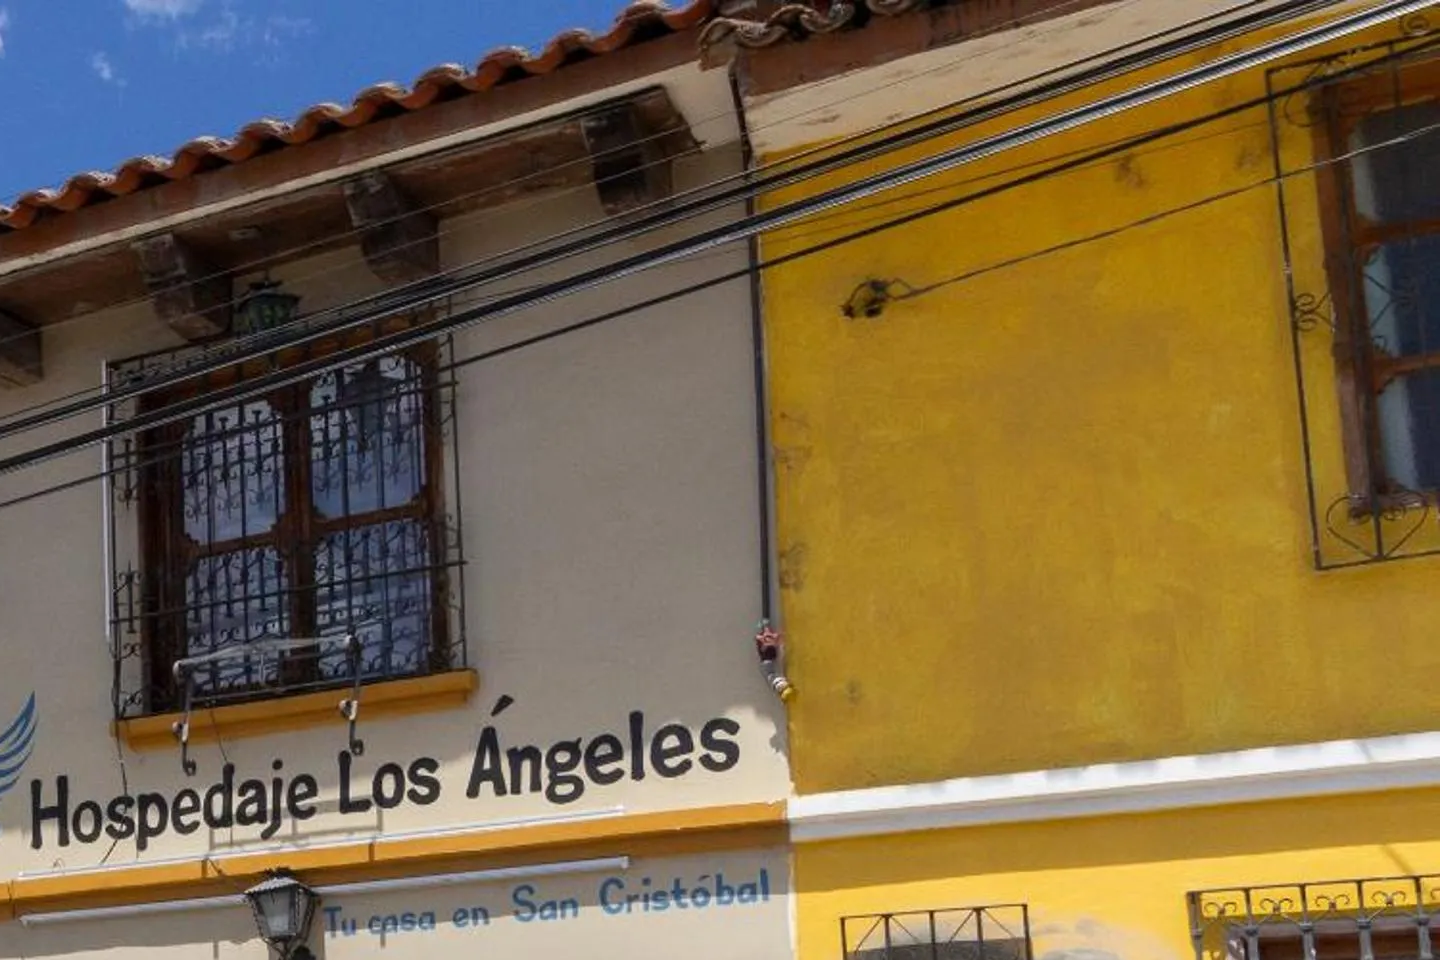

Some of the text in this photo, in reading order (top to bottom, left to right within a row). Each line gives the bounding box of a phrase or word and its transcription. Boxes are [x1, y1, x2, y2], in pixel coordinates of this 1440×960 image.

[30, 694, 741, 851] Hospedaje Los Ángeles
[323, 867, 769, 938] Tu casa en San Cristóbal
